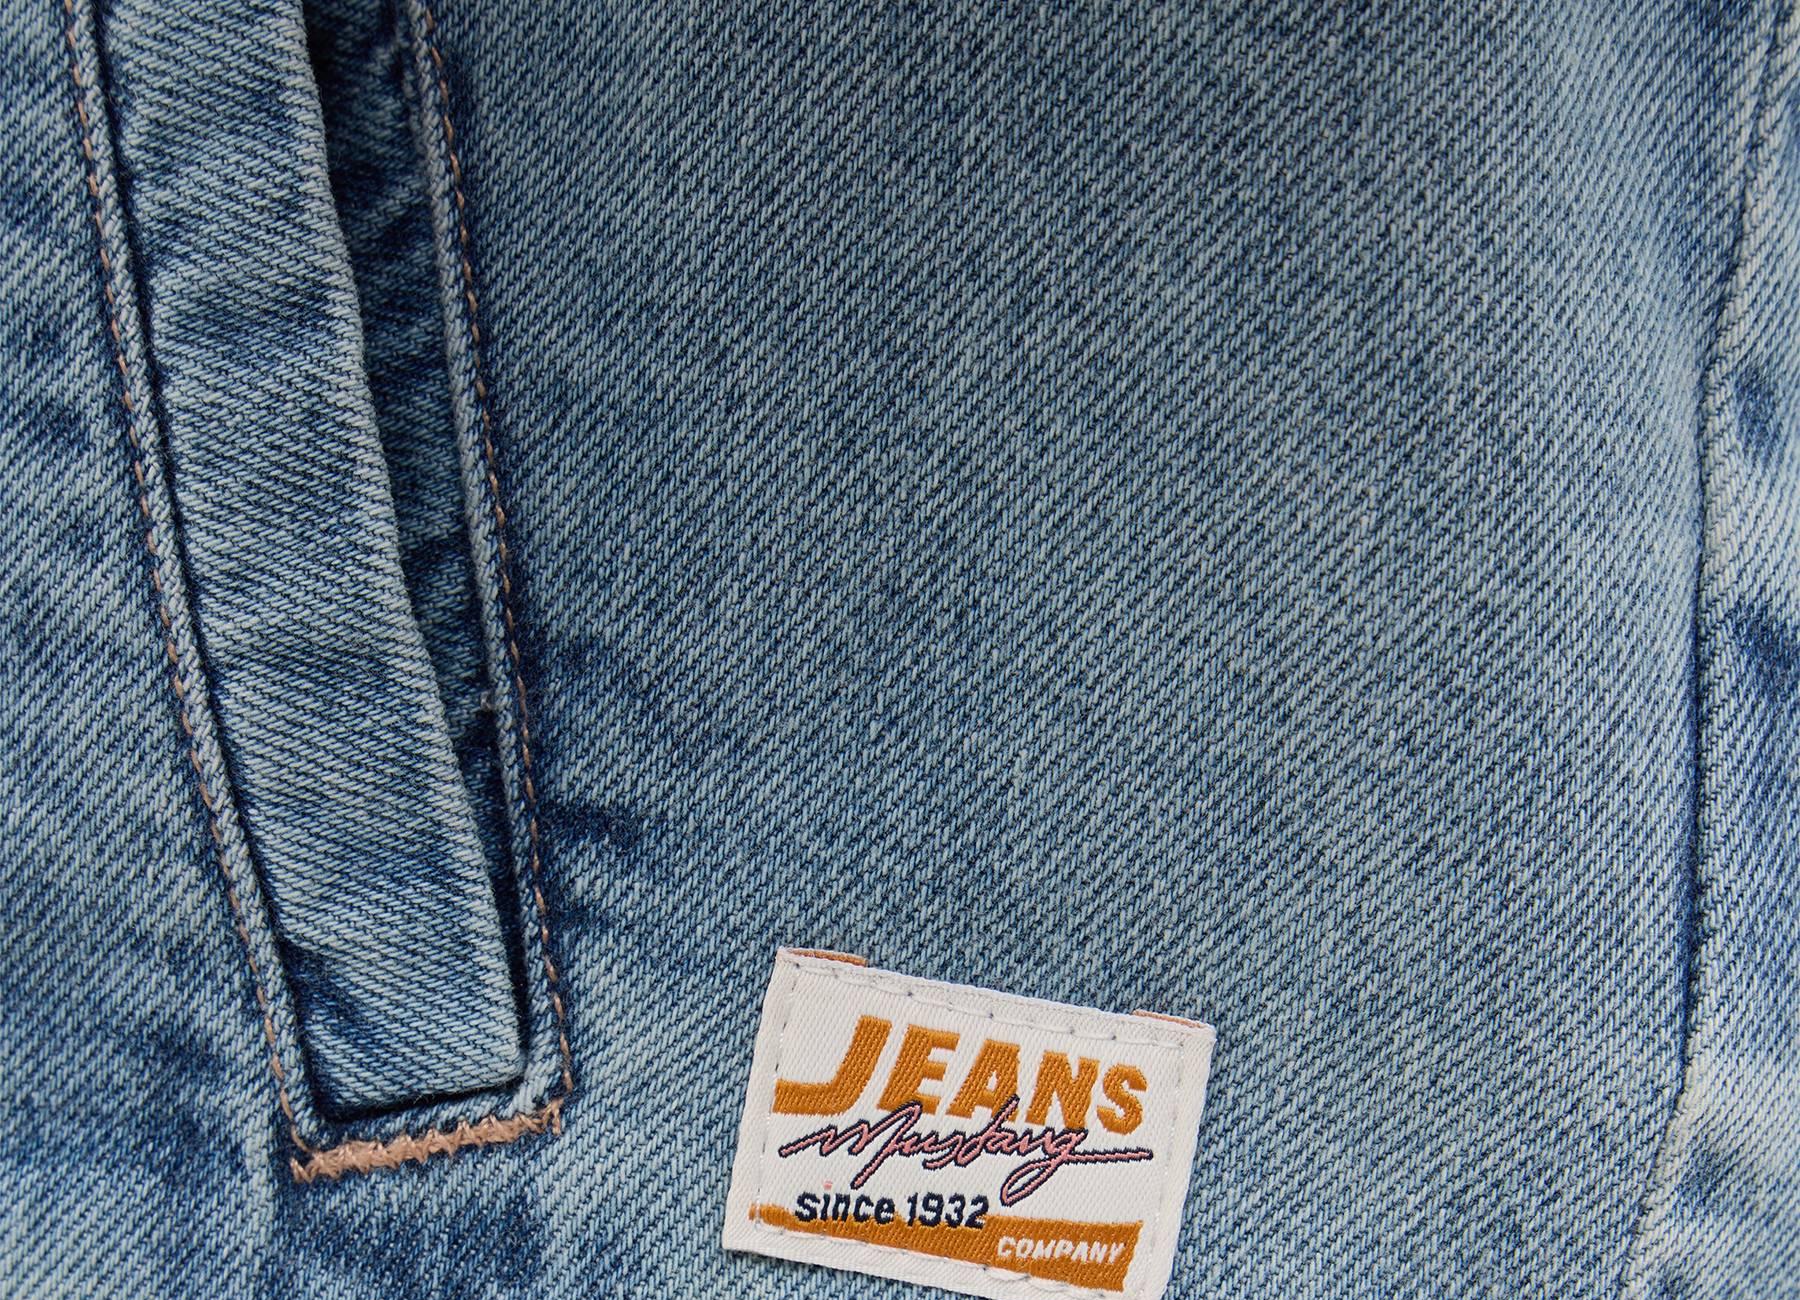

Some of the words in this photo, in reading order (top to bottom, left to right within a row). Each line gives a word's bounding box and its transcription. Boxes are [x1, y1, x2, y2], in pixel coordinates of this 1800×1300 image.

[772, 1015, 1148, 1136] JEANS
[778, 1094, 1154, 1207] Mustang
[794, 1182, 895, 1225] since
[906, 1192, 990, 1230] 1932
[996, 1236, 1126, 1266] COMPANY
